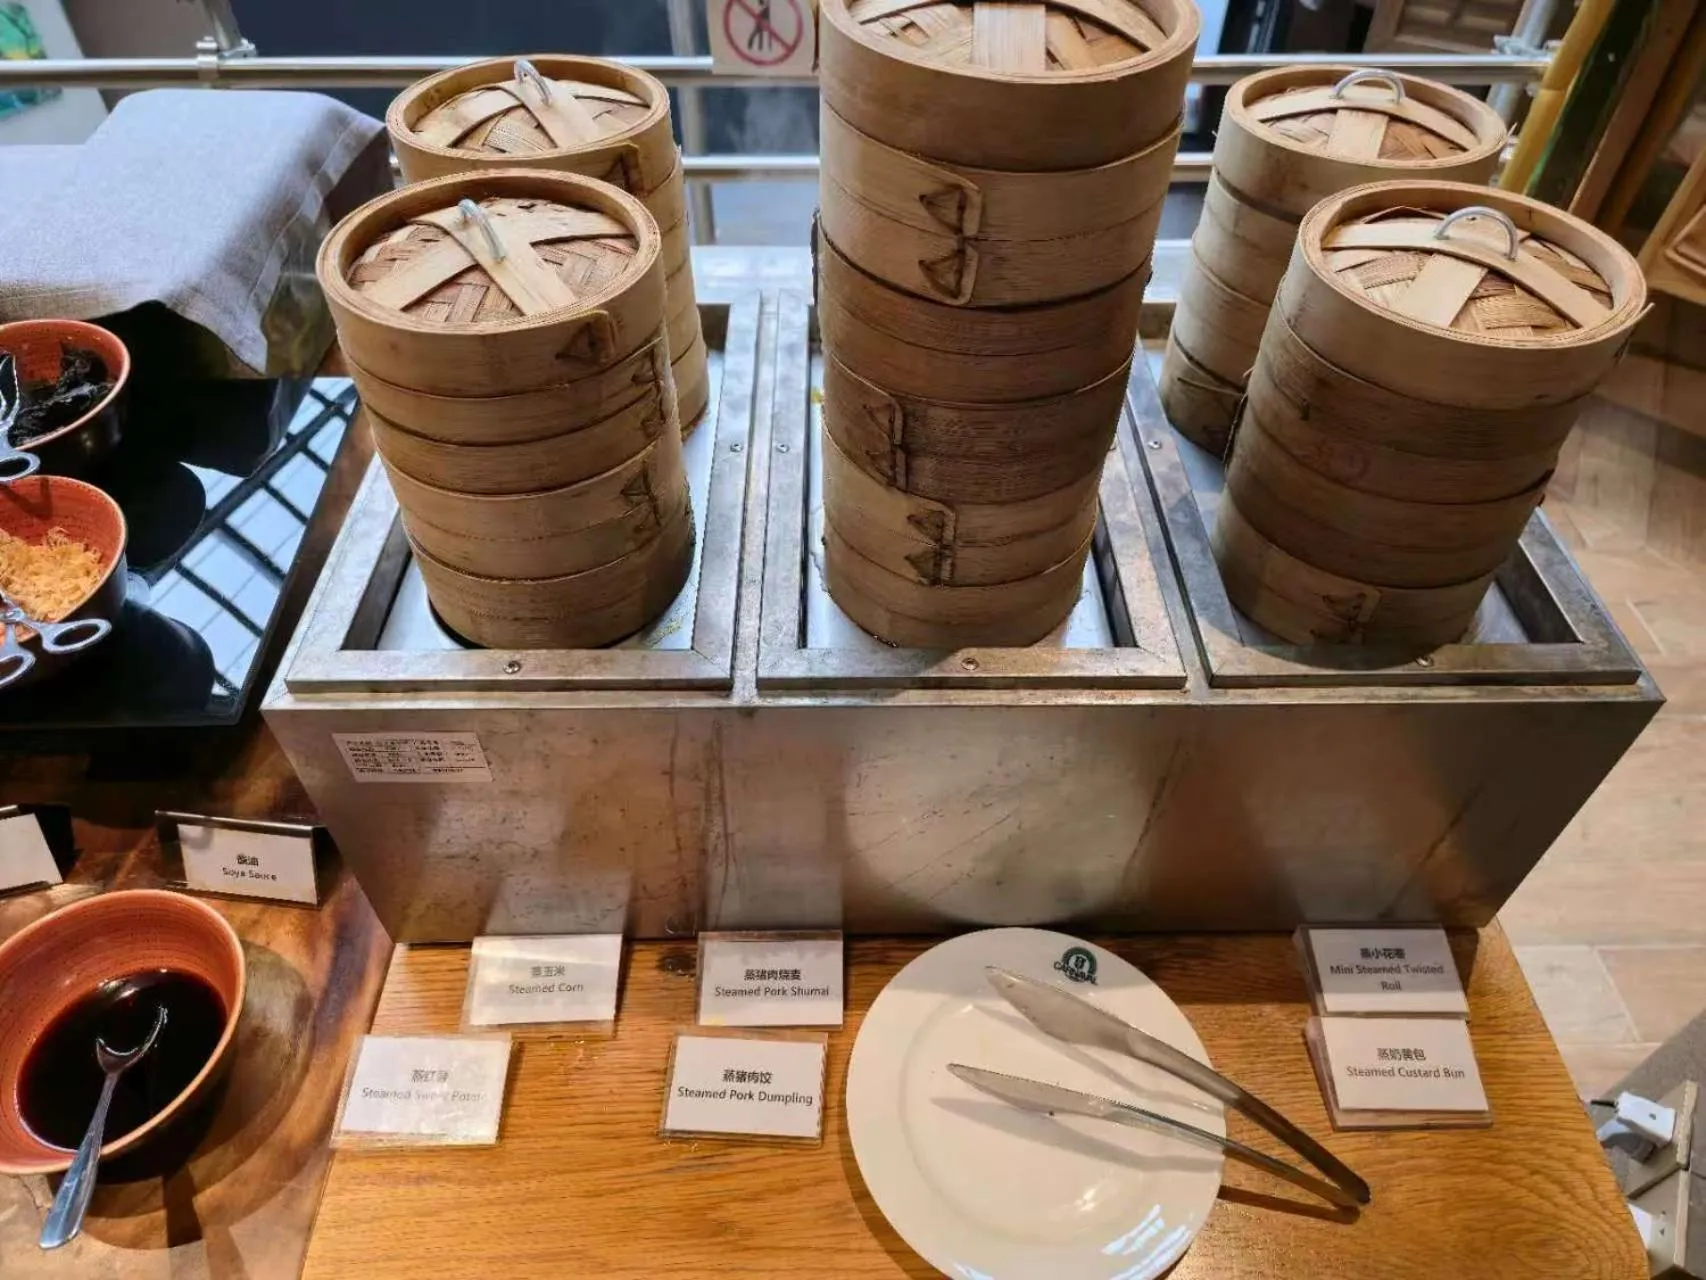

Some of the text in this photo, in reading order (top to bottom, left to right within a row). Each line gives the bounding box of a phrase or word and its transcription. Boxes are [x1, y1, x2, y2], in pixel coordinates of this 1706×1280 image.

[1330, 963, 1444, 975] Mini Steamed Twisted
[508, 982, 584, 994] Steamed Corn
[715, 986, 761, 997] Steamed
[764, 986, 787, 997] Pork
[1381, 980, 1402, 991] Roll
[1346, 1066, 1466, 1079] Steamed Custard Bun
[362, 1087, 412, 1101] Steamed
[677, 1086, 813, 1107] Steamed Pork Dumpling
